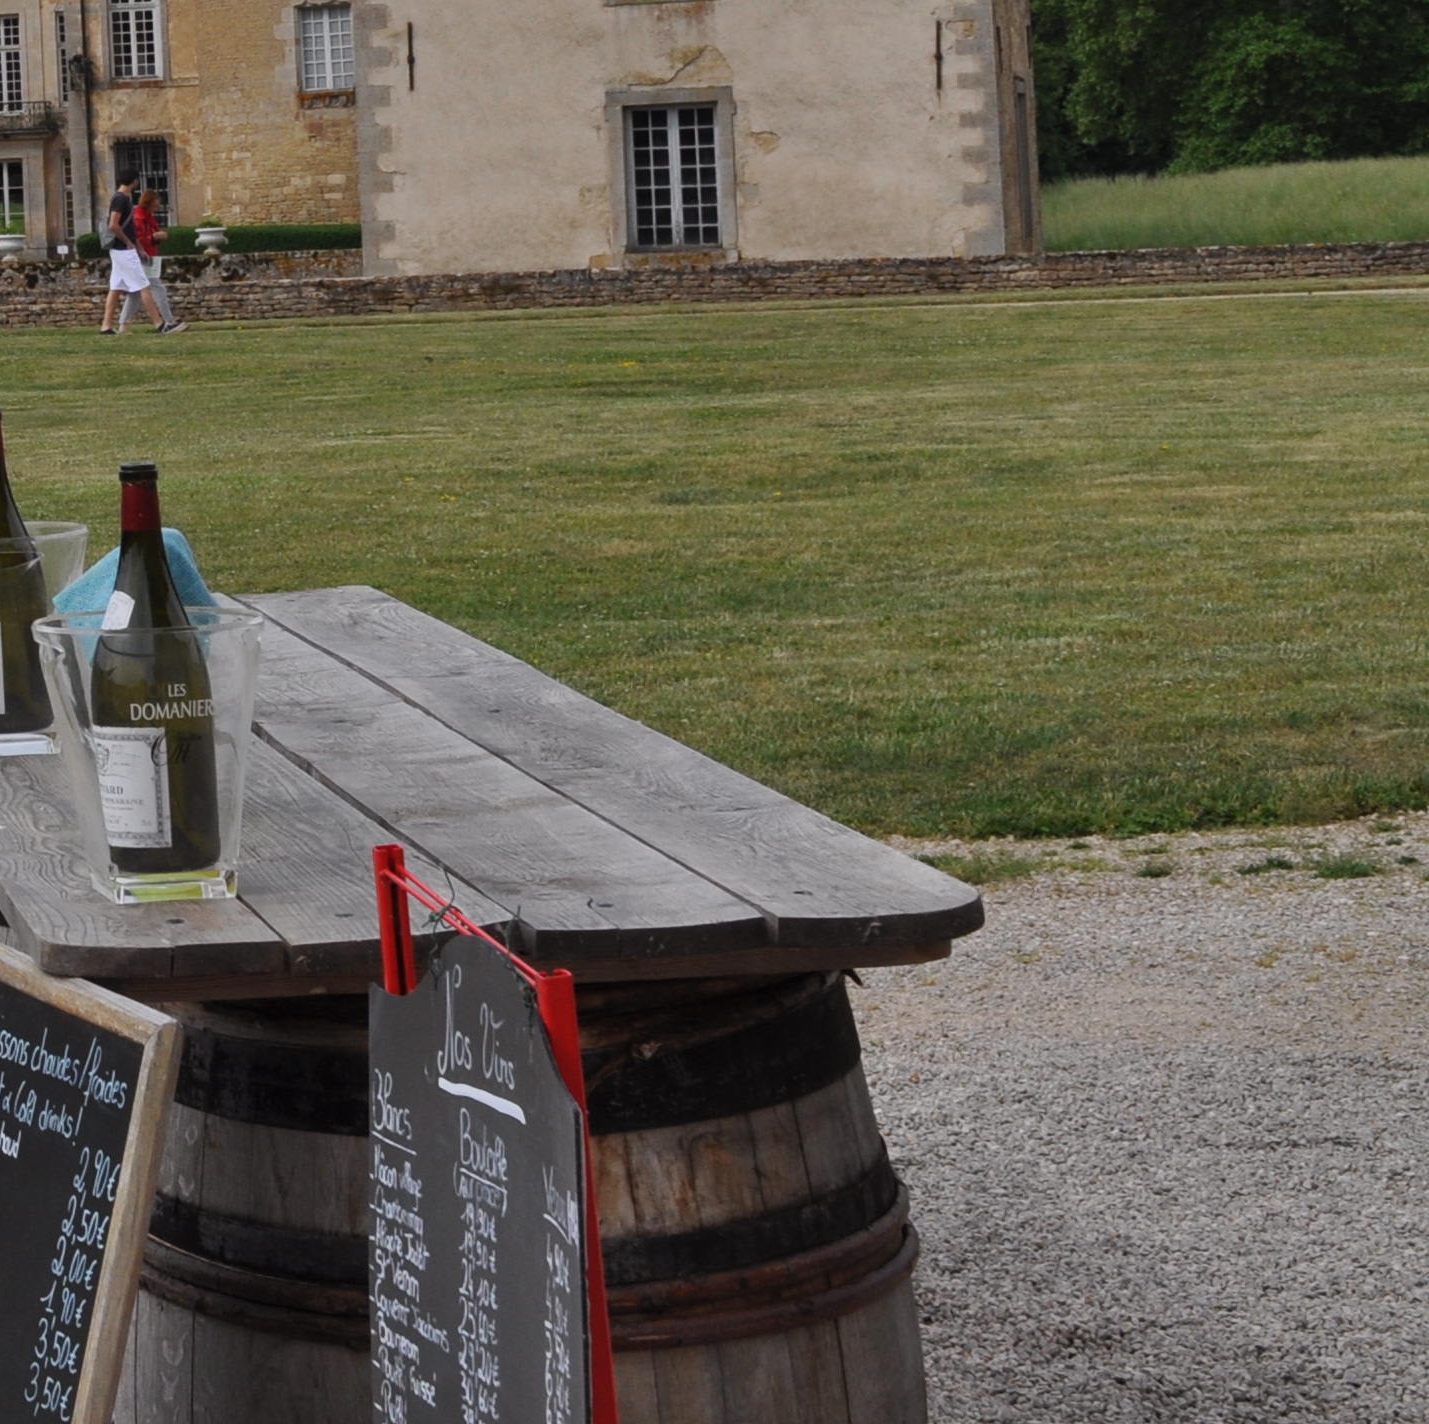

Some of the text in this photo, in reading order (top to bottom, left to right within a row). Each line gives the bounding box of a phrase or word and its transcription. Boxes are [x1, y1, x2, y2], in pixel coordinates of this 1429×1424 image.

[167, 683, 187, 698] LES
[437, 964, 515, 1091] Nos Vins
[13, 1080, 37, 1127] Cold
